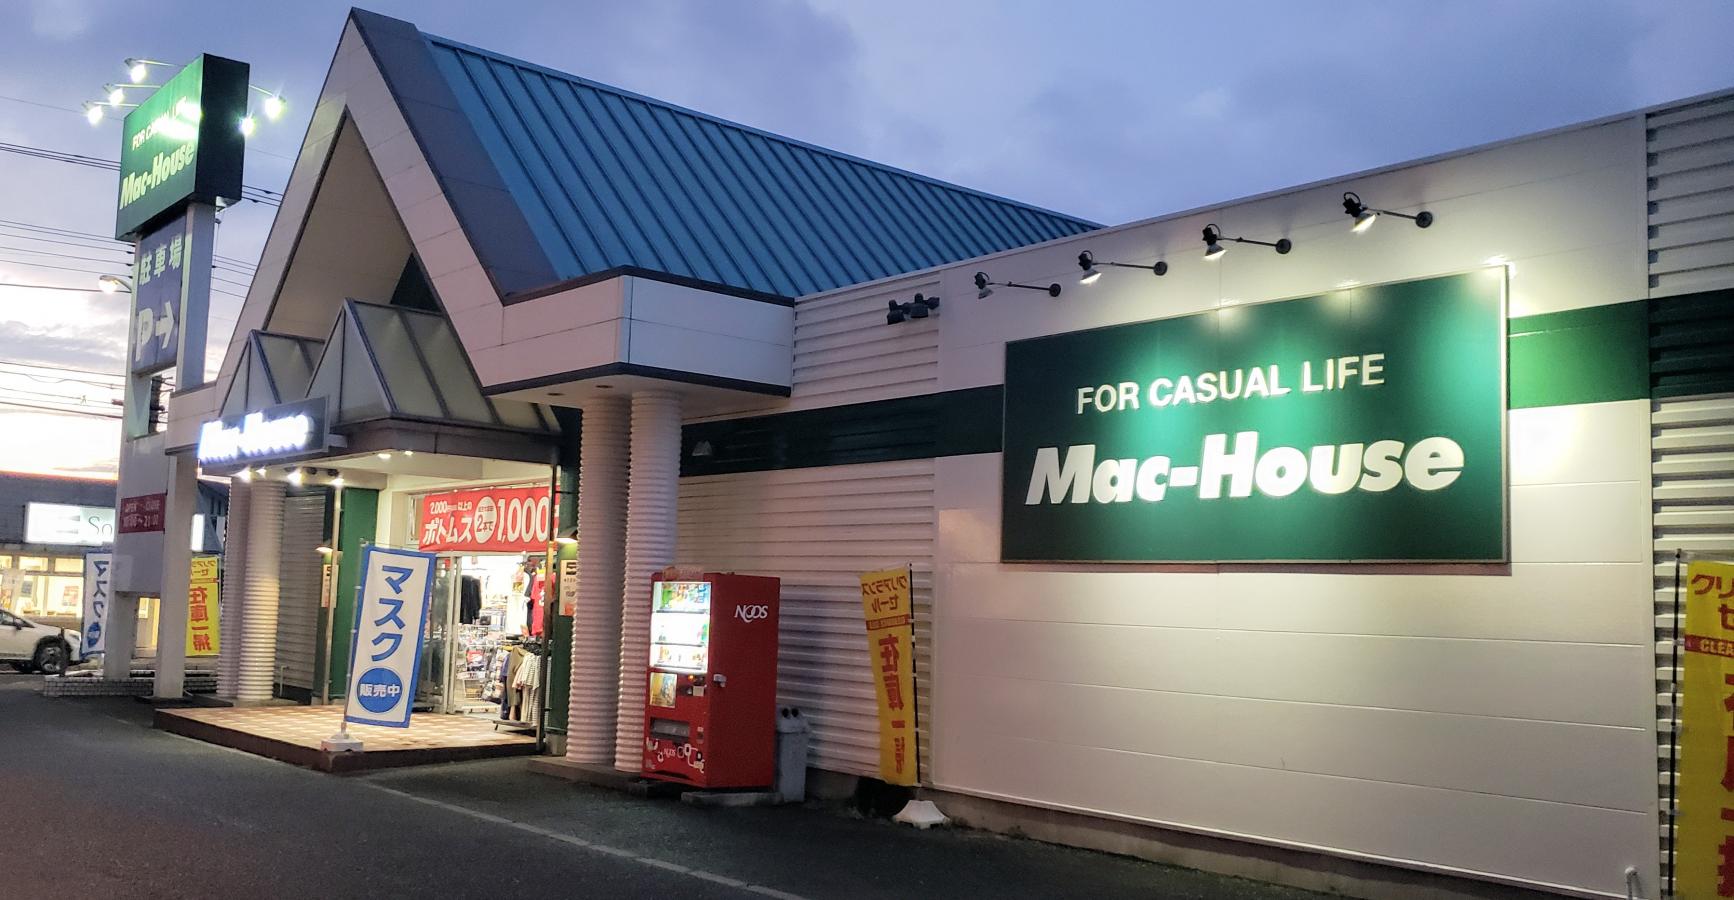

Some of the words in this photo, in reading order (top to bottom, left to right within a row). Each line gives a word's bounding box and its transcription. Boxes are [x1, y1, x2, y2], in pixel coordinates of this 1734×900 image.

[119, 141, 195, 210] Mac-House
[138, 234, 183, 286] 駐車場
[135, 308, 154, 362] P
[1077, 381, 1140, 415] FOR
[1148, 365, 1293, 408] CASUAL
[1302, 353, 1386, 393] LIFE
[1024, 430, 1465, 506] Mac-House
[422, 517, 473, 545] ボトムス
[371, 564, 414, 662] マスク
[359, 683, 401, 698] 販売中
